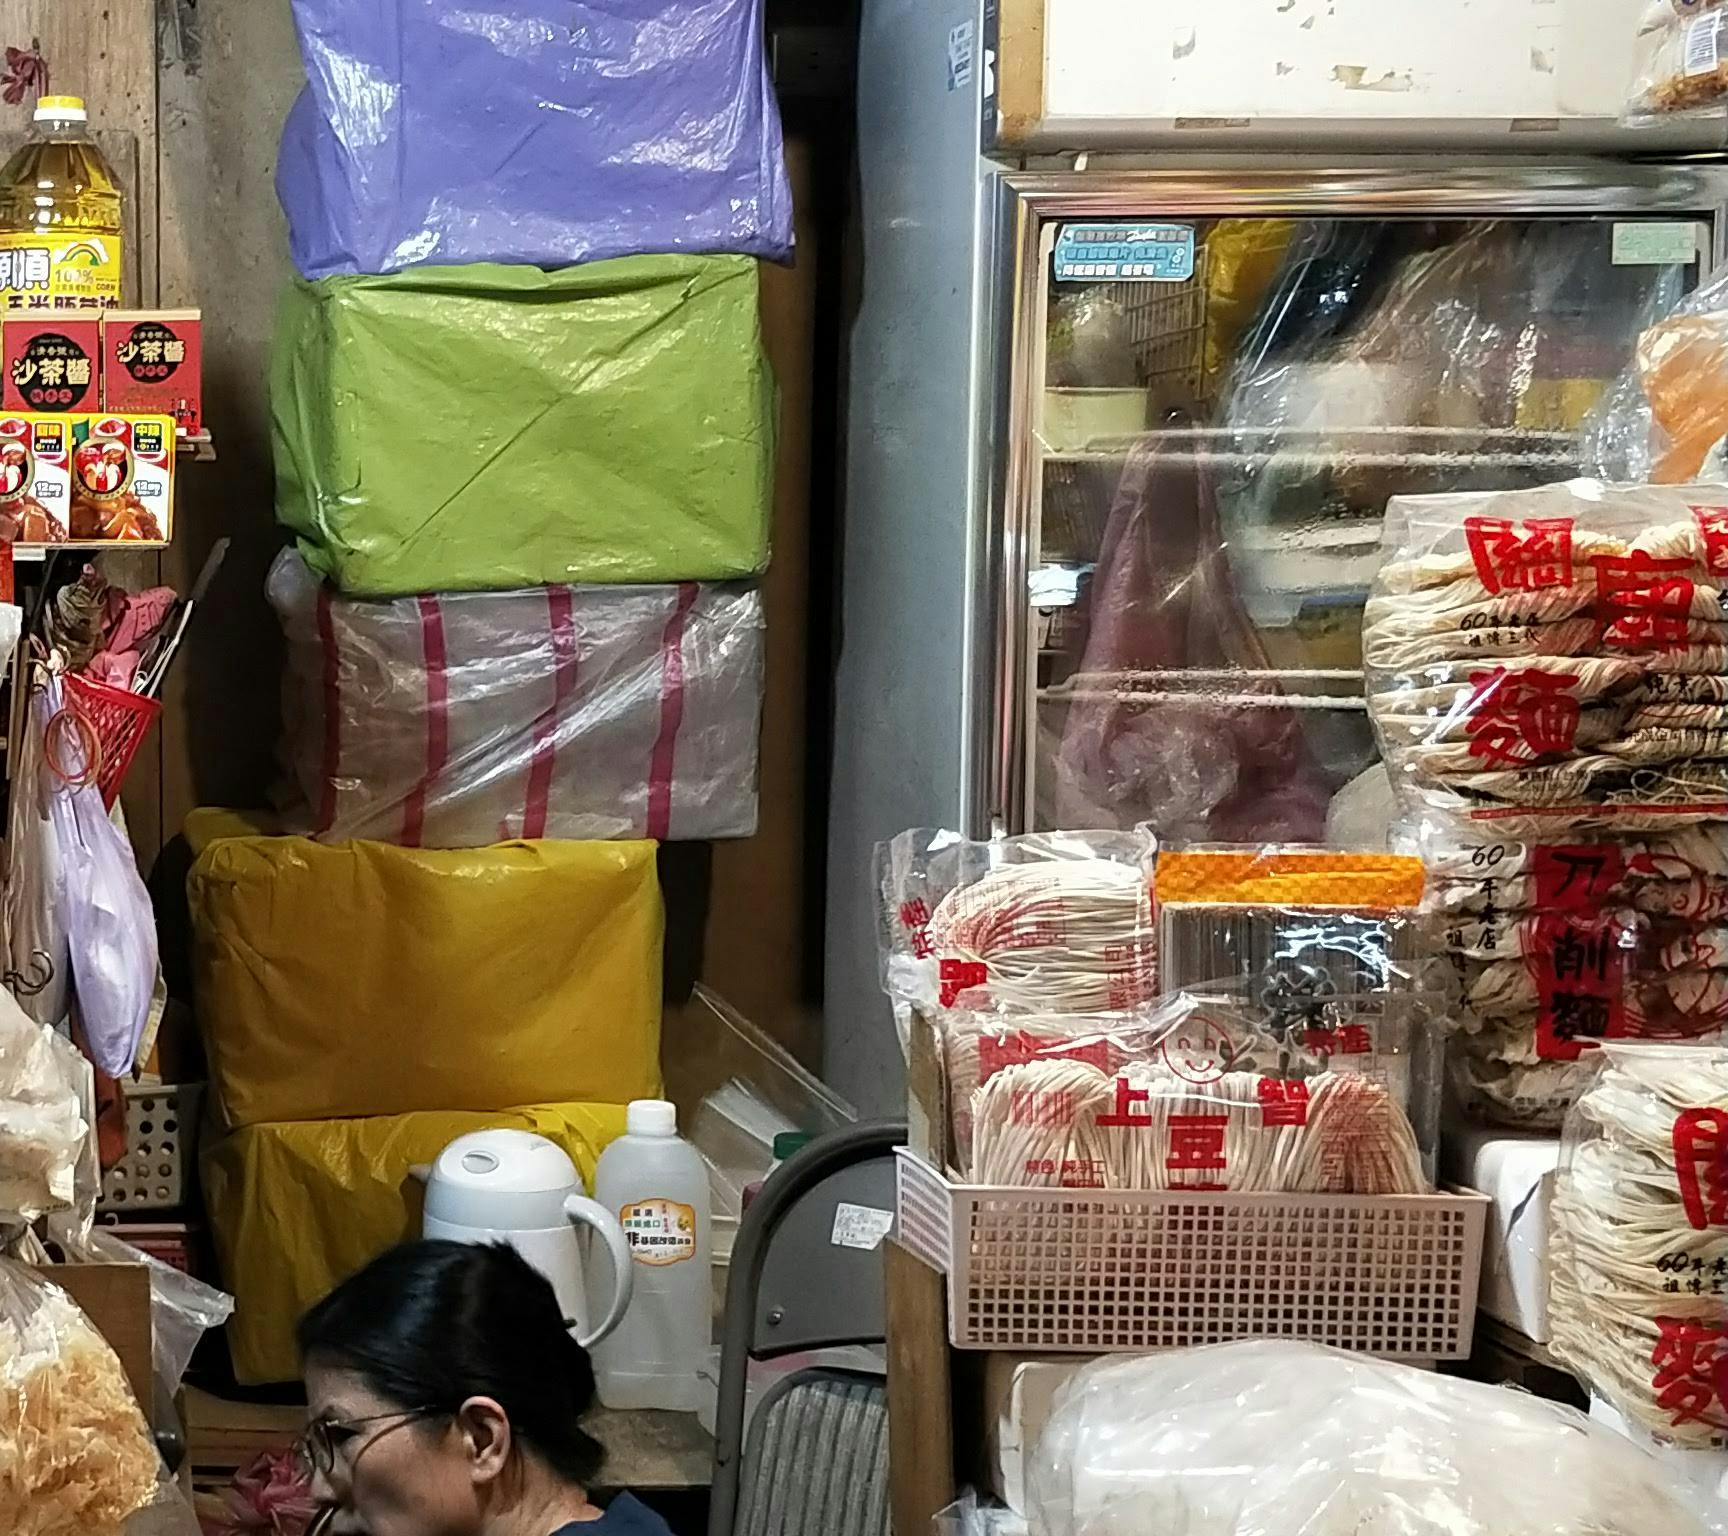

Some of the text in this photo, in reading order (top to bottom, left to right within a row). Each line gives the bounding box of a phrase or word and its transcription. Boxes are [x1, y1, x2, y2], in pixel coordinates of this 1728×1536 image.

[115, 340, 186, 364] 沙茶醬
[11, 357, 92, 387] 沙茶醬
